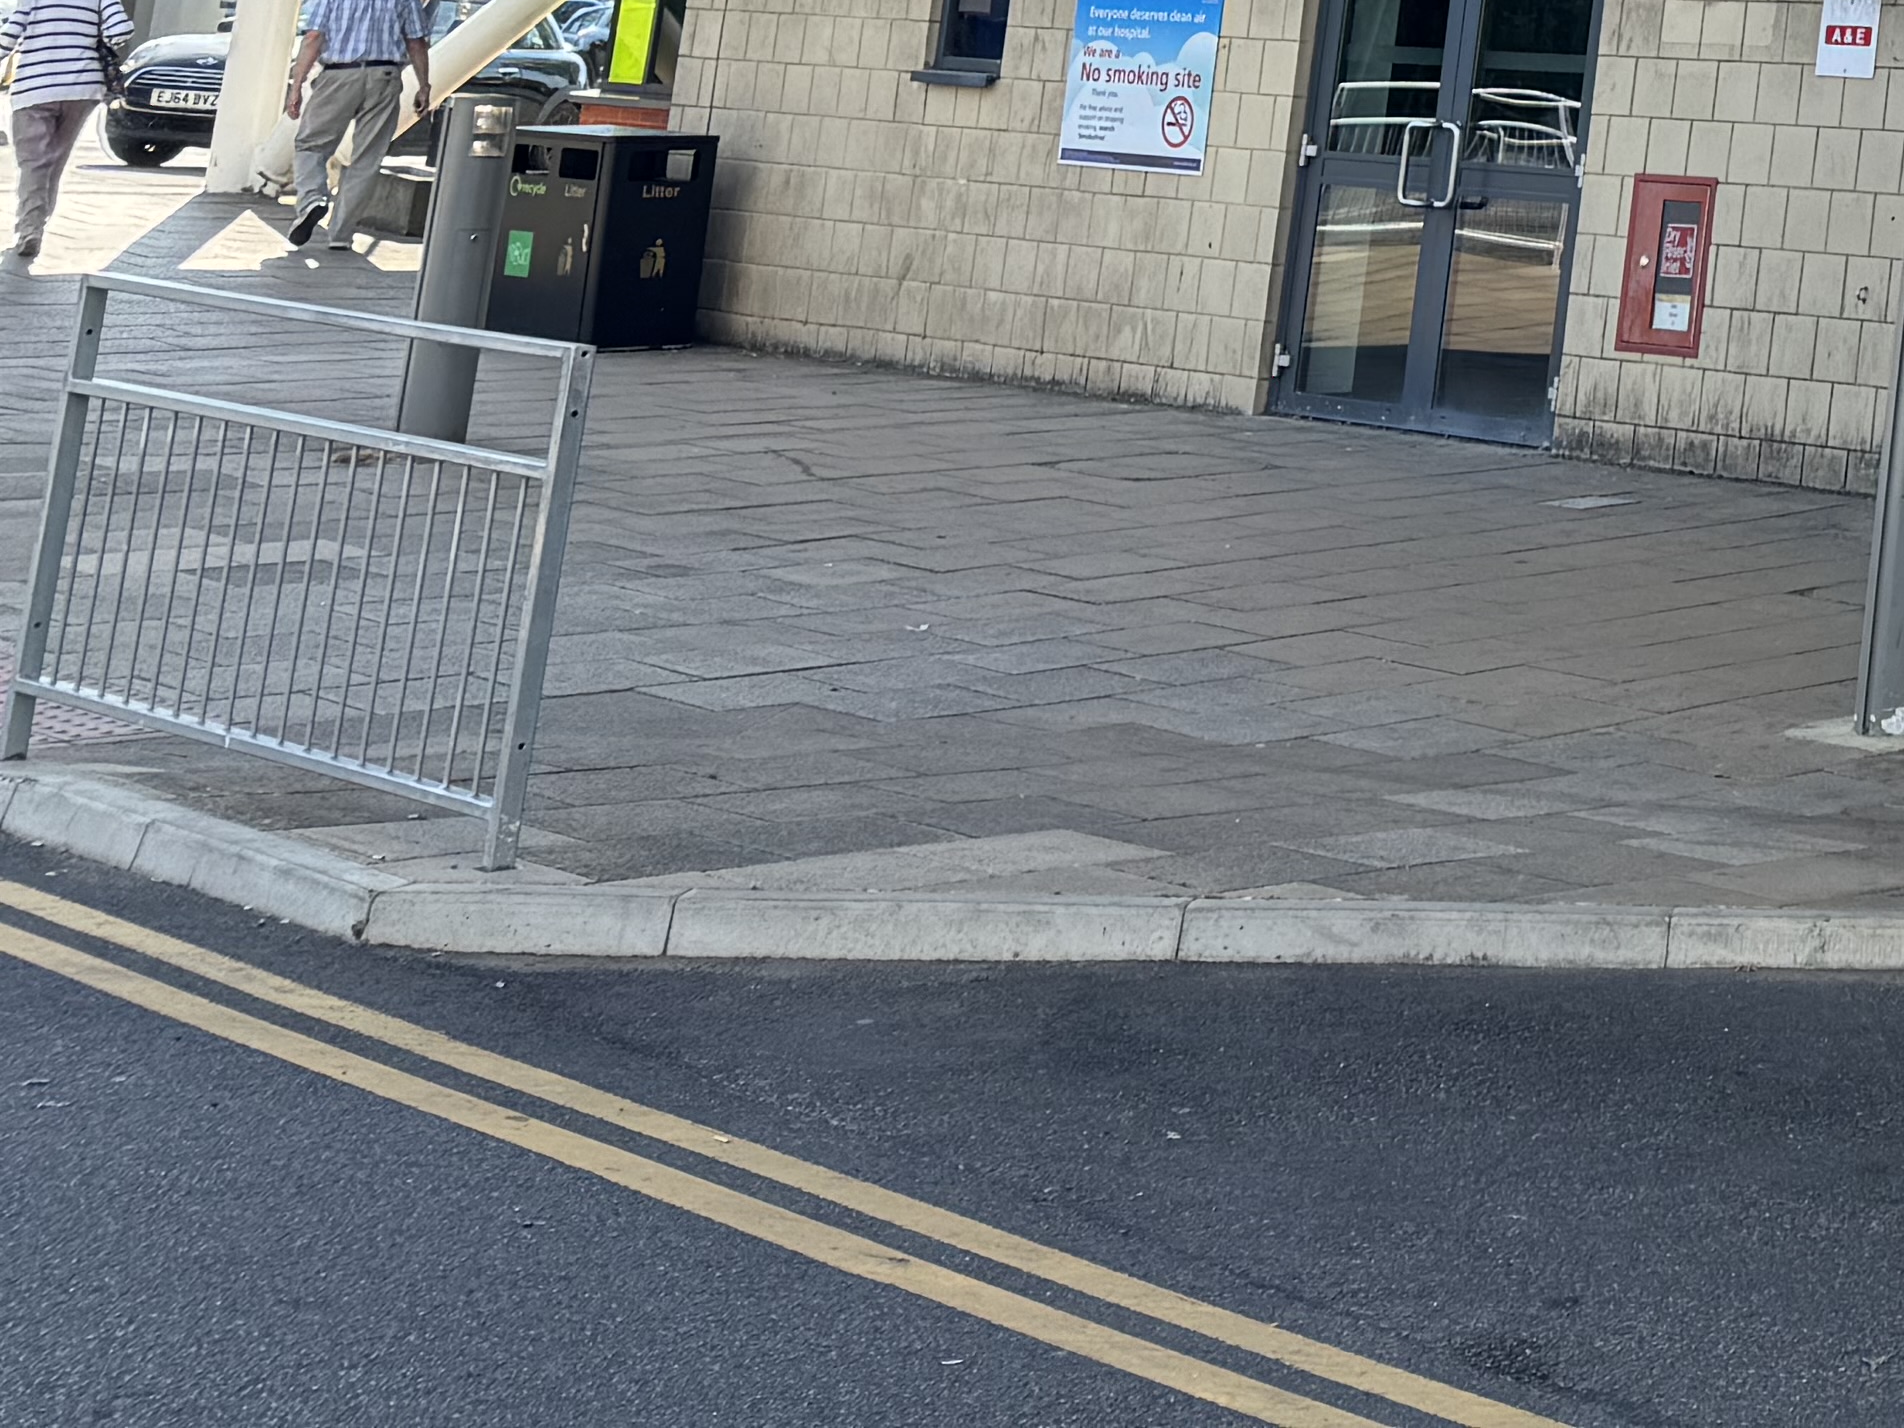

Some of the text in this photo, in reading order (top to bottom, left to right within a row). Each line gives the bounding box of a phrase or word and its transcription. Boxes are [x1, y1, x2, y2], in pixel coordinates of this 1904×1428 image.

[1089, 6, 1206, 23] Everyone deserves clean air
[1097, 27, 1112, 37] our
[1832, 27, 1865, 45] A&E
[1083, 45, 1121, 59] We are a
[1080, 62, 1202, 92] No smoking site
[642, 185, 681, 199] Litter
